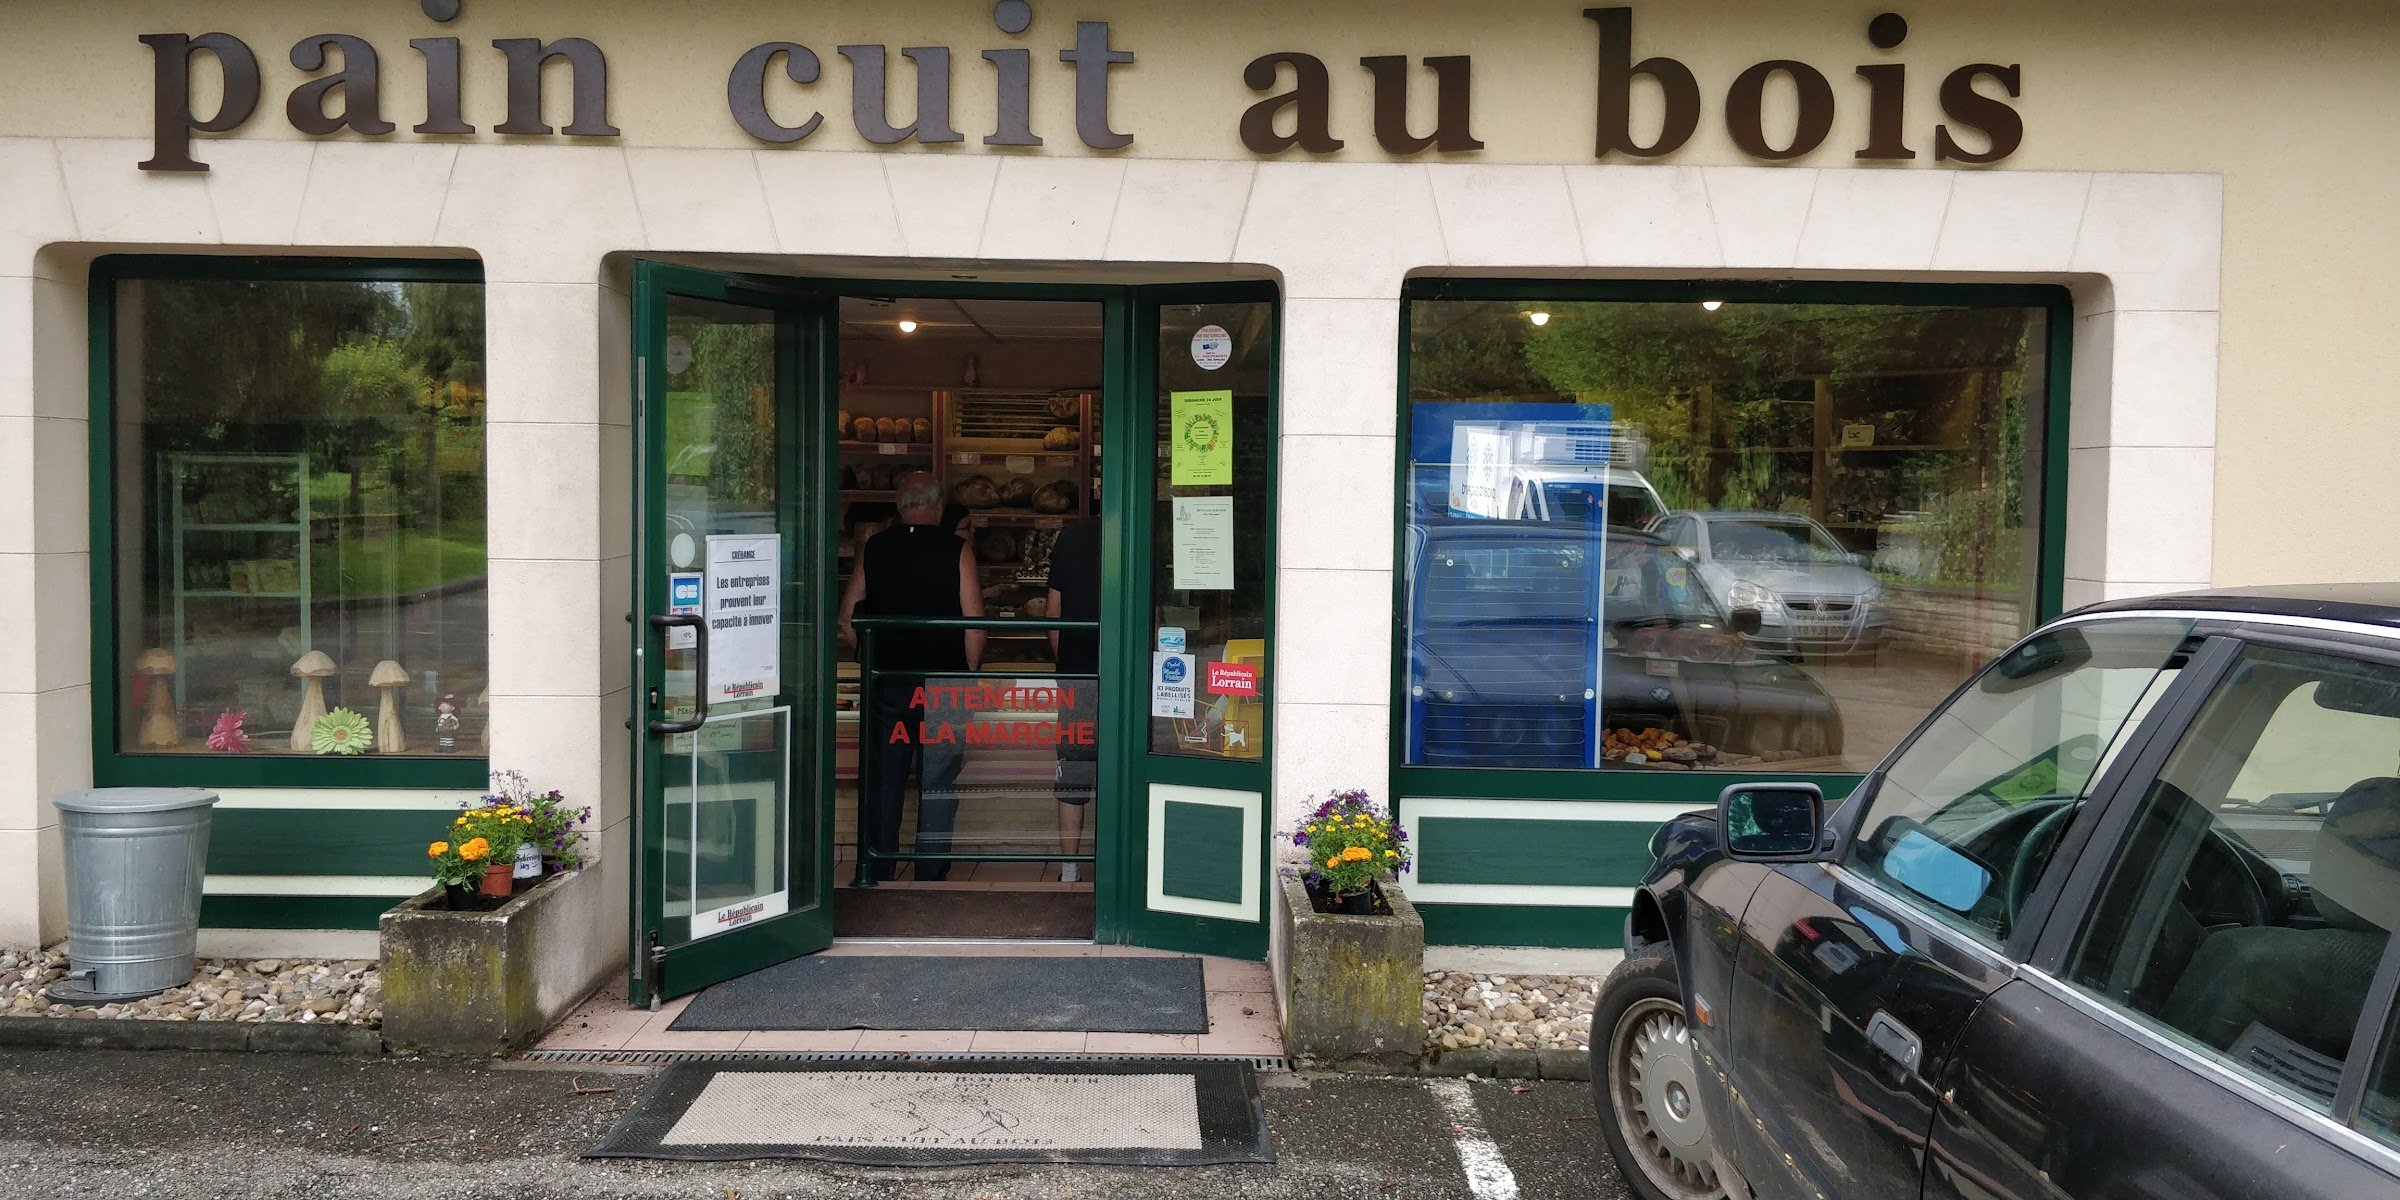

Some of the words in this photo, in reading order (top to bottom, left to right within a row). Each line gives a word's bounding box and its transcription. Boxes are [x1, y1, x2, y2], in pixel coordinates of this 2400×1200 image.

[138, 0, 621, 172] pain
[727, 0, 1134, 150] cuit
[1239, 51, 1485, 154] au
[1583, 7, 2024, 163] bois
[716, 576, 729, 589] Les
[730, 574, 770, 588] entreprises
[720, 594, 752, 611] prouvent
[753, 594, 767, 606] leur
[749, 614, 774, 626] innover
[1211, 668, 1220, 676] Le
[1220, 669, 1253, 678] Républicain
[724, 684, 731, 692] Le
[732, 680, 764, 692] Républicain
[1165, 685, 1191, 693] PRODUITS
[1211, 675, 1252, 689] Lorrain
[733, 690, 754, 698] Lorrain
[909, 686, 1075, 710] ATTENTION
[888, 721, 910, 744] A
[919, 721, 956, 744] LA
[965, 721, 1095, 745] MARCHE
[718, 911, 727, 921] Le
[727, 902, 764, 918] Républicain
[729, 914, 753, 926] Lorrain
